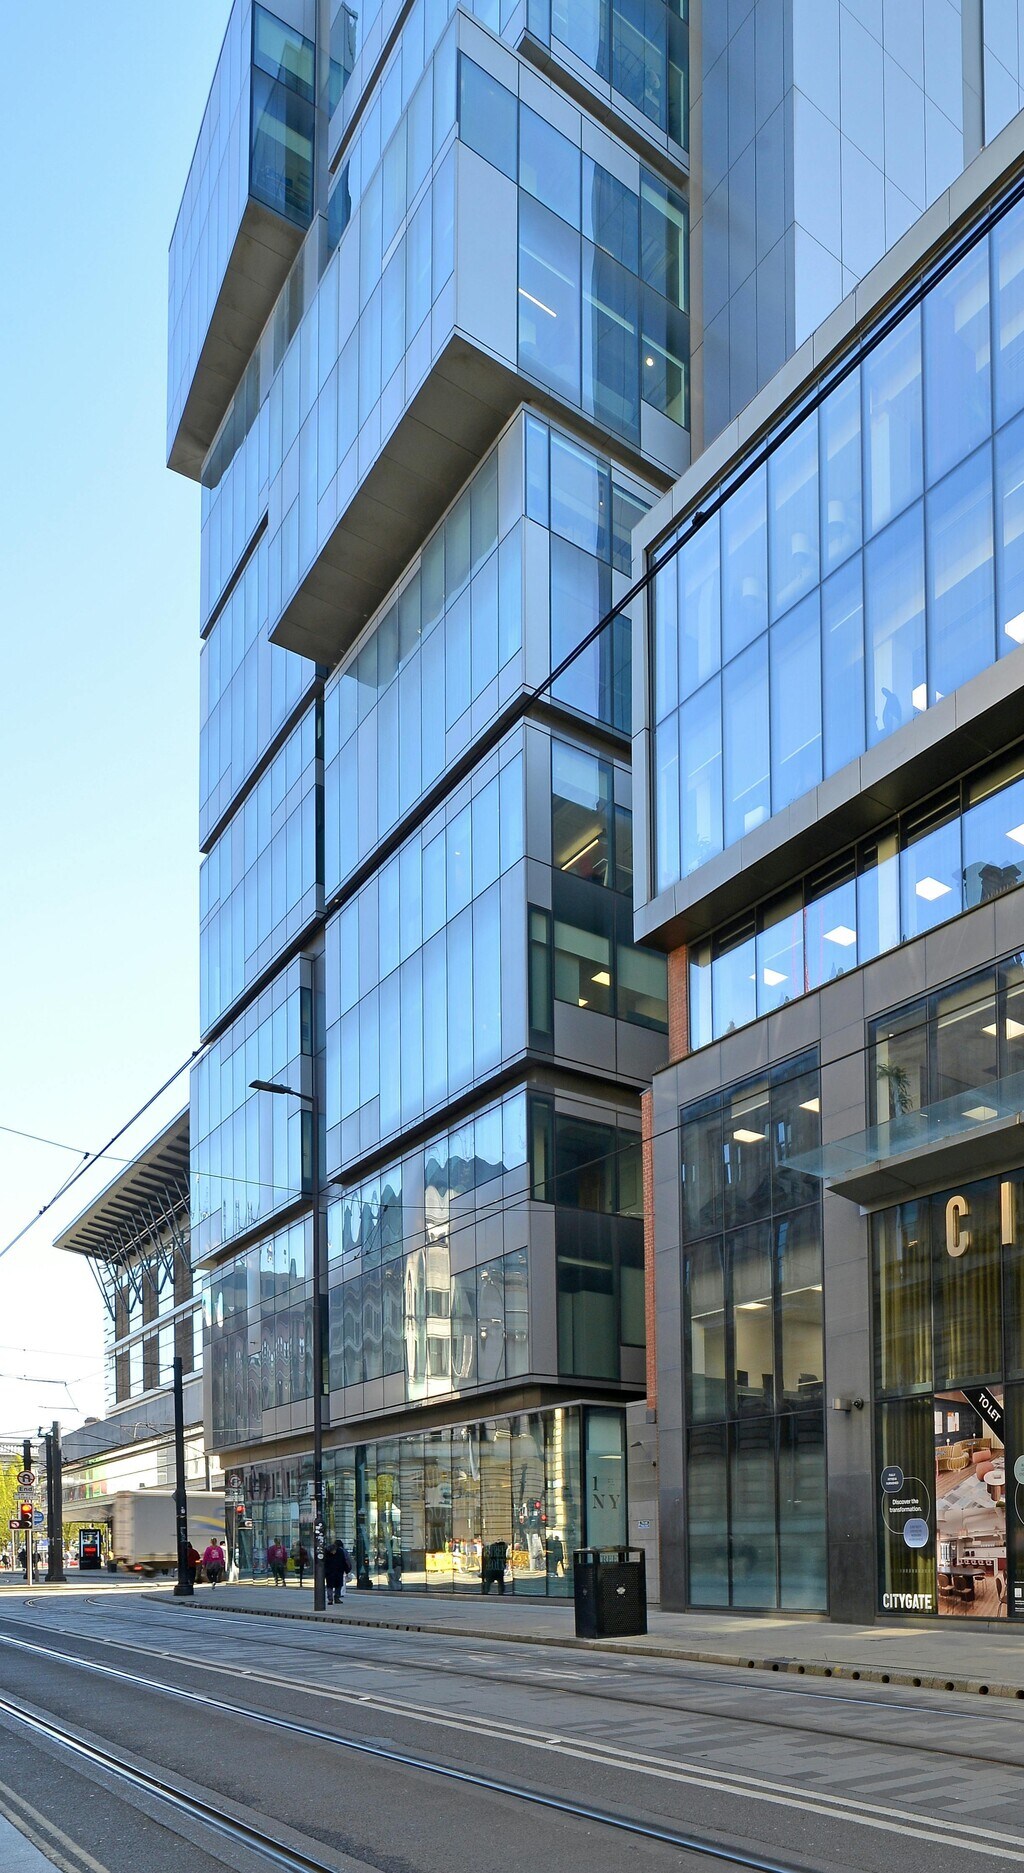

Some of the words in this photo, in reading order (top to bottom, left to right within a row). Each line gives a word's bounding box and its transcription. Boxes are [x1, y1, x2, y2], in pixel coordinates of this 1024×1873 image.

[979, 1392, 989, 1409] TO
[987, 1405, 1001, 1422] LET
[889, 1505, 922, 1513] transformation.
[882, 1593, 933, 1610] CITYGATE
